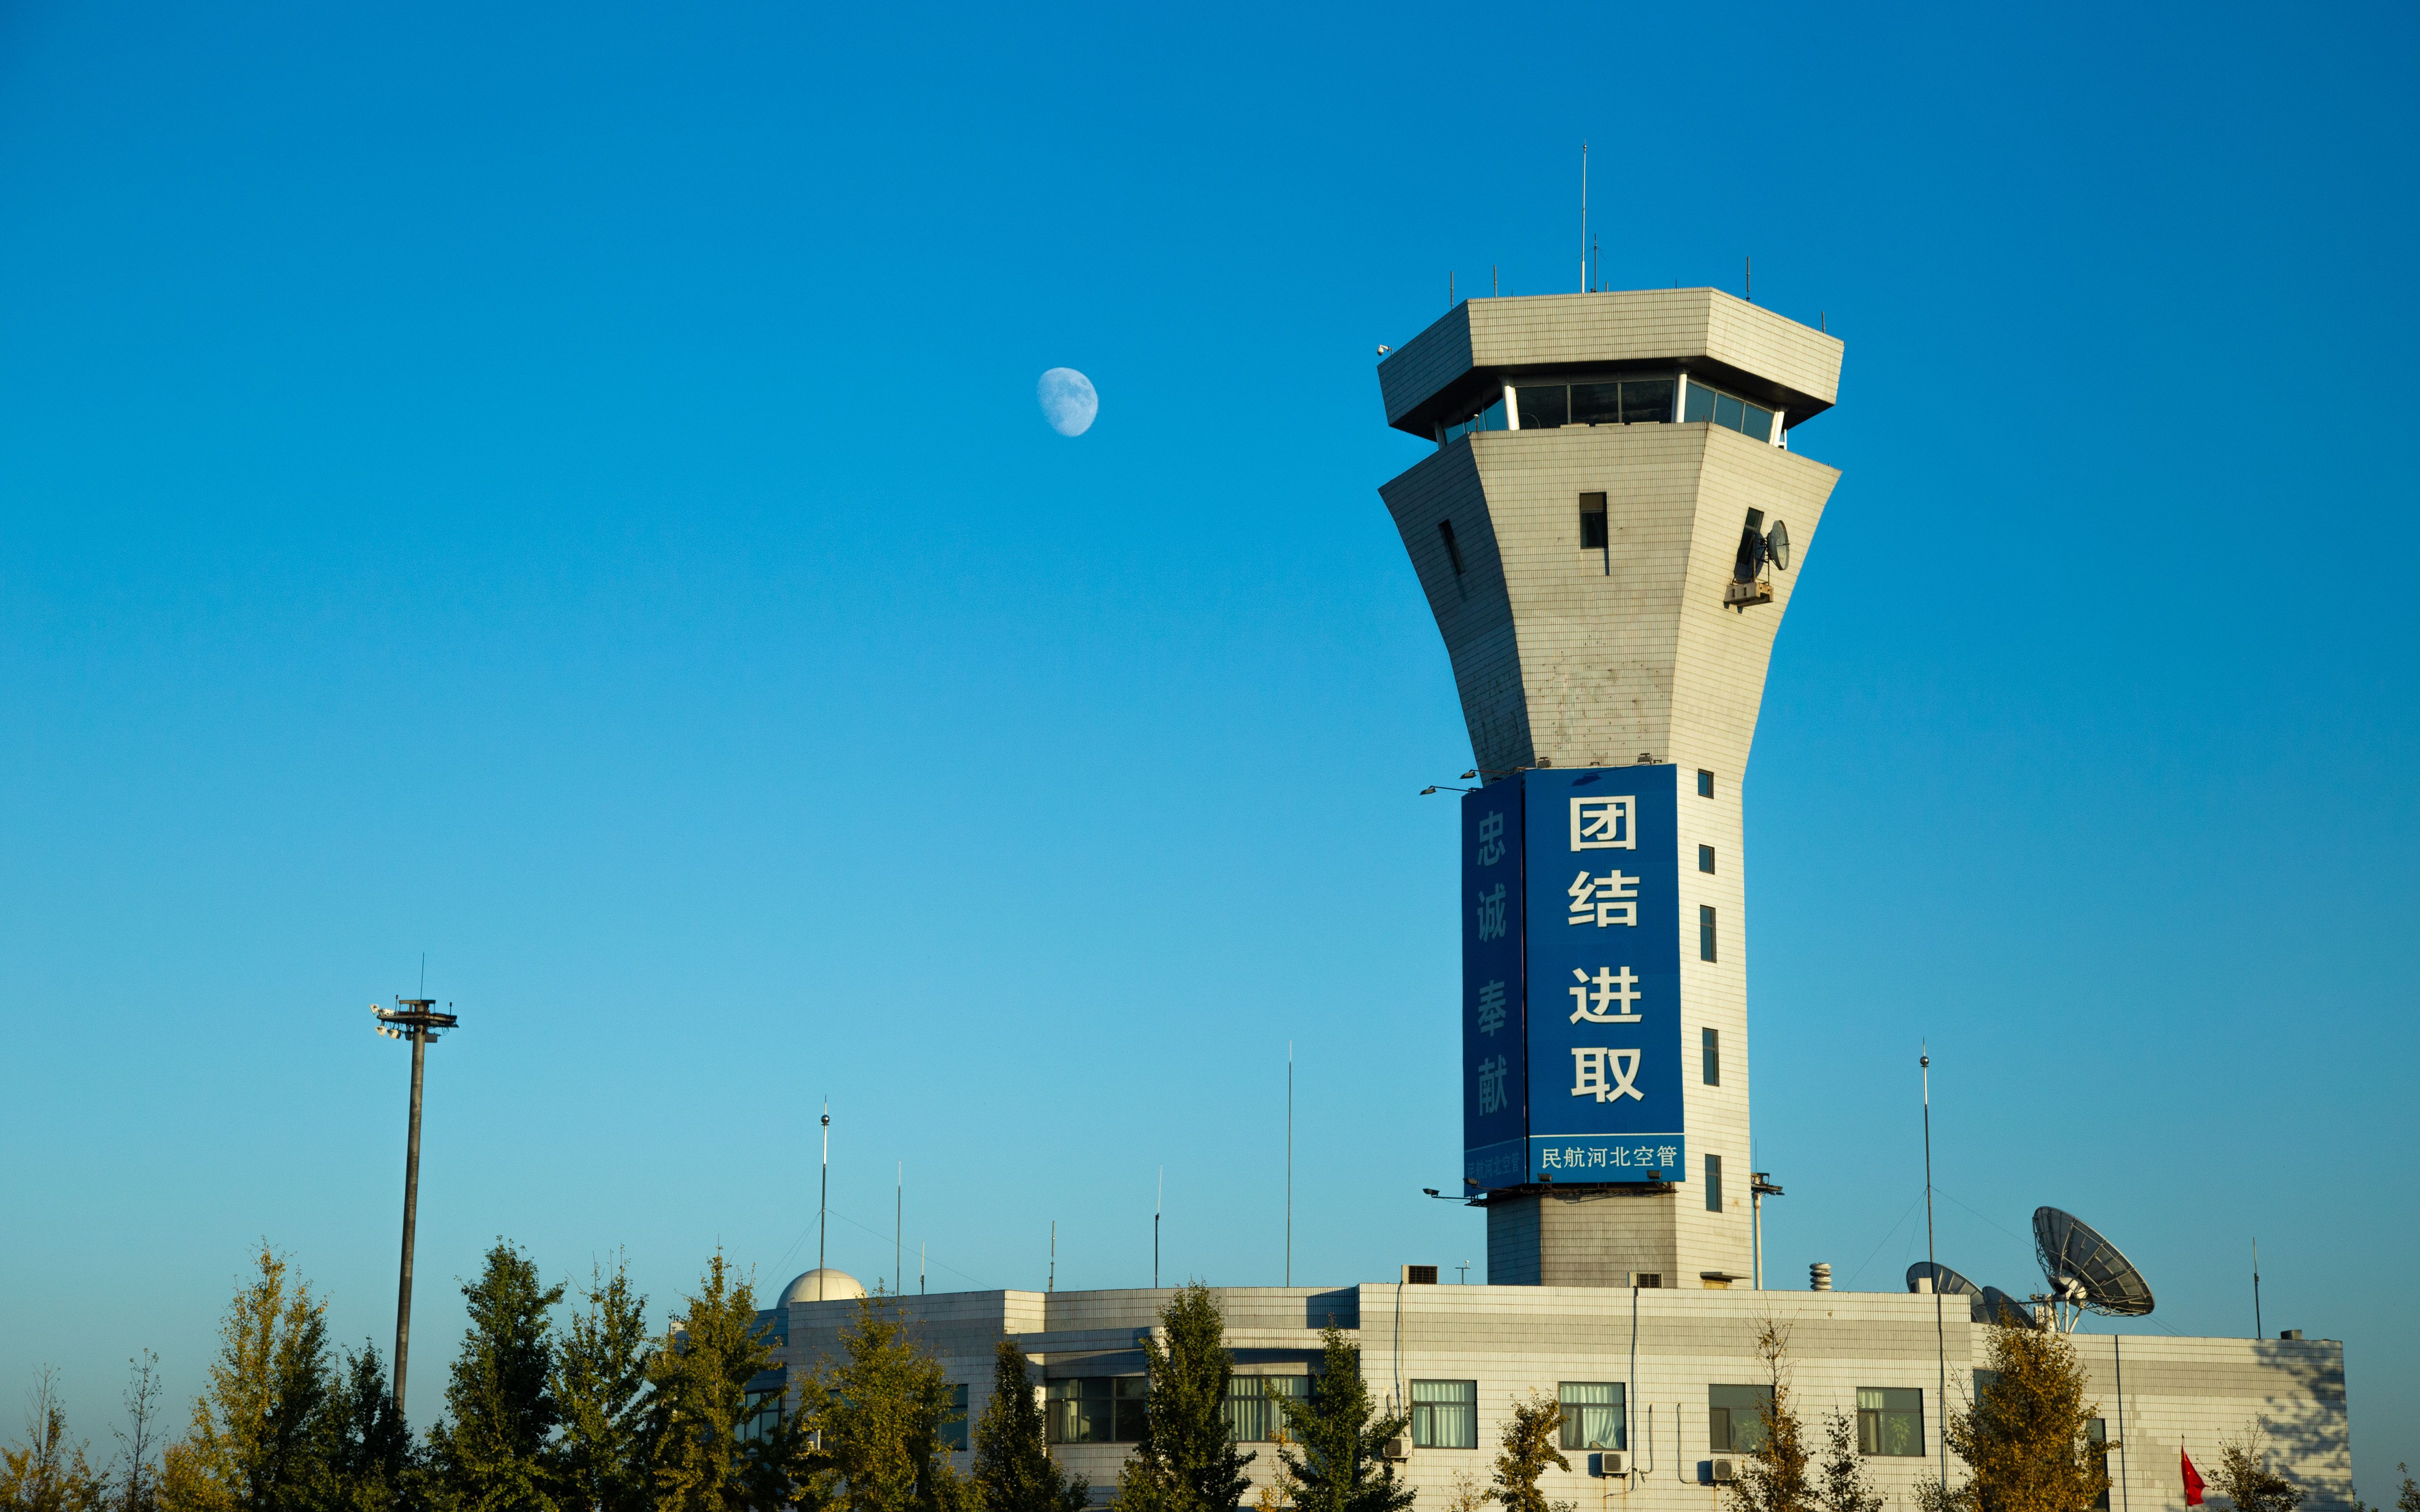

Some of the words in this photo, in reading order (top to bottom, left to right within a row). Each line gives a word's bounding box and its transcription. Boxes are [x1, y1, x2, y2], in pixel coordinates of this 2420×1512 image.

[1477, 810, 1507, 1117] 忠诚奉献
[1568, 795, 1644, 1103] 团结进取
[1467, 1151, 1520, 1180] 民航河北空管
[1542, 1145, 1677, 1169] 民航河北空管
